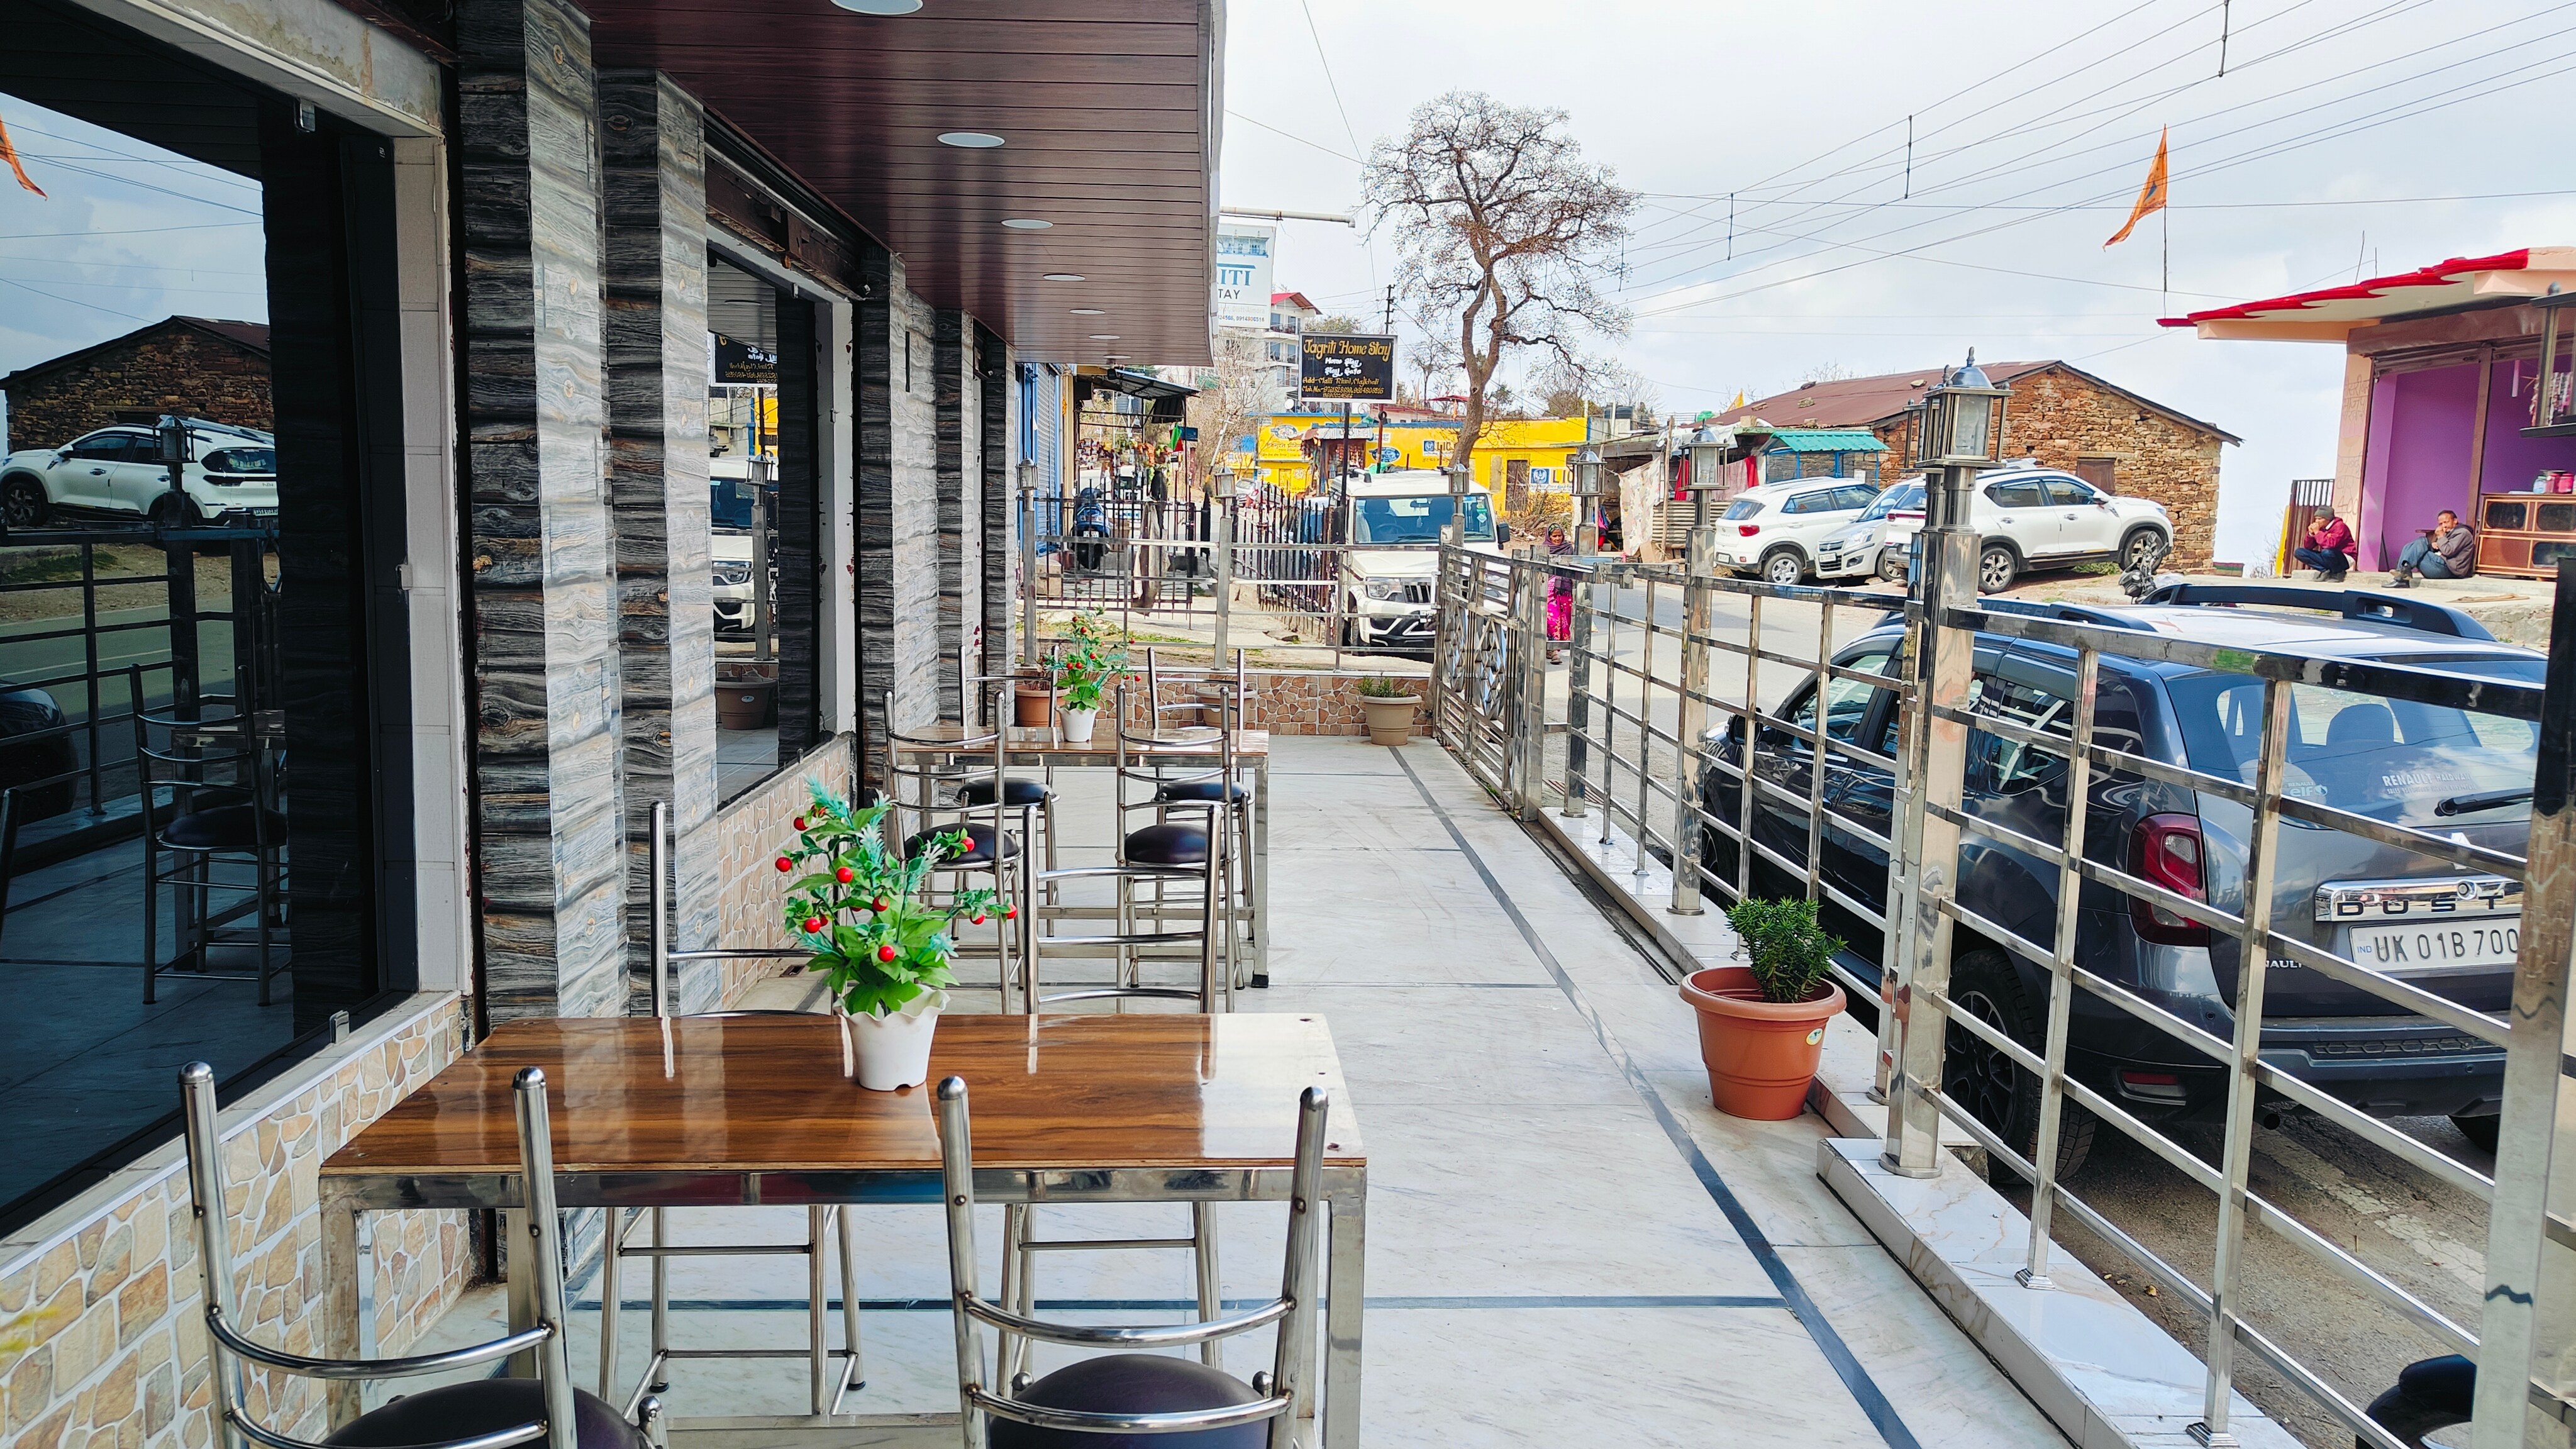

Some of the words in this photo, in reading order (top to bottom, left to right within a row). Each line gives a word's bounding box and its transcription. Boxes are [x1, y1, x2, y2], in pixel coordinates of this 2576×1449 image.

[1218, 269, 1251, 286] ITI
[1303, 338, 1337, 360] Jagriti
[1339, 340, 1367, 355] Home
[1368, 341, 1392, 362] Stay
[1344, 357, 1362, 368] Stay
[1324, 367, 1343, 377] Stay
[2382, 774, 2432, 786] RENAULT
[2290, 786, 2313, 797] elf
[2357, 945, 2372, 953] IND
[2375, 935, 2408, 962] UK
[2417, 932, 2465, 960] 01B
[2473, 928, 2518, 955] 700
